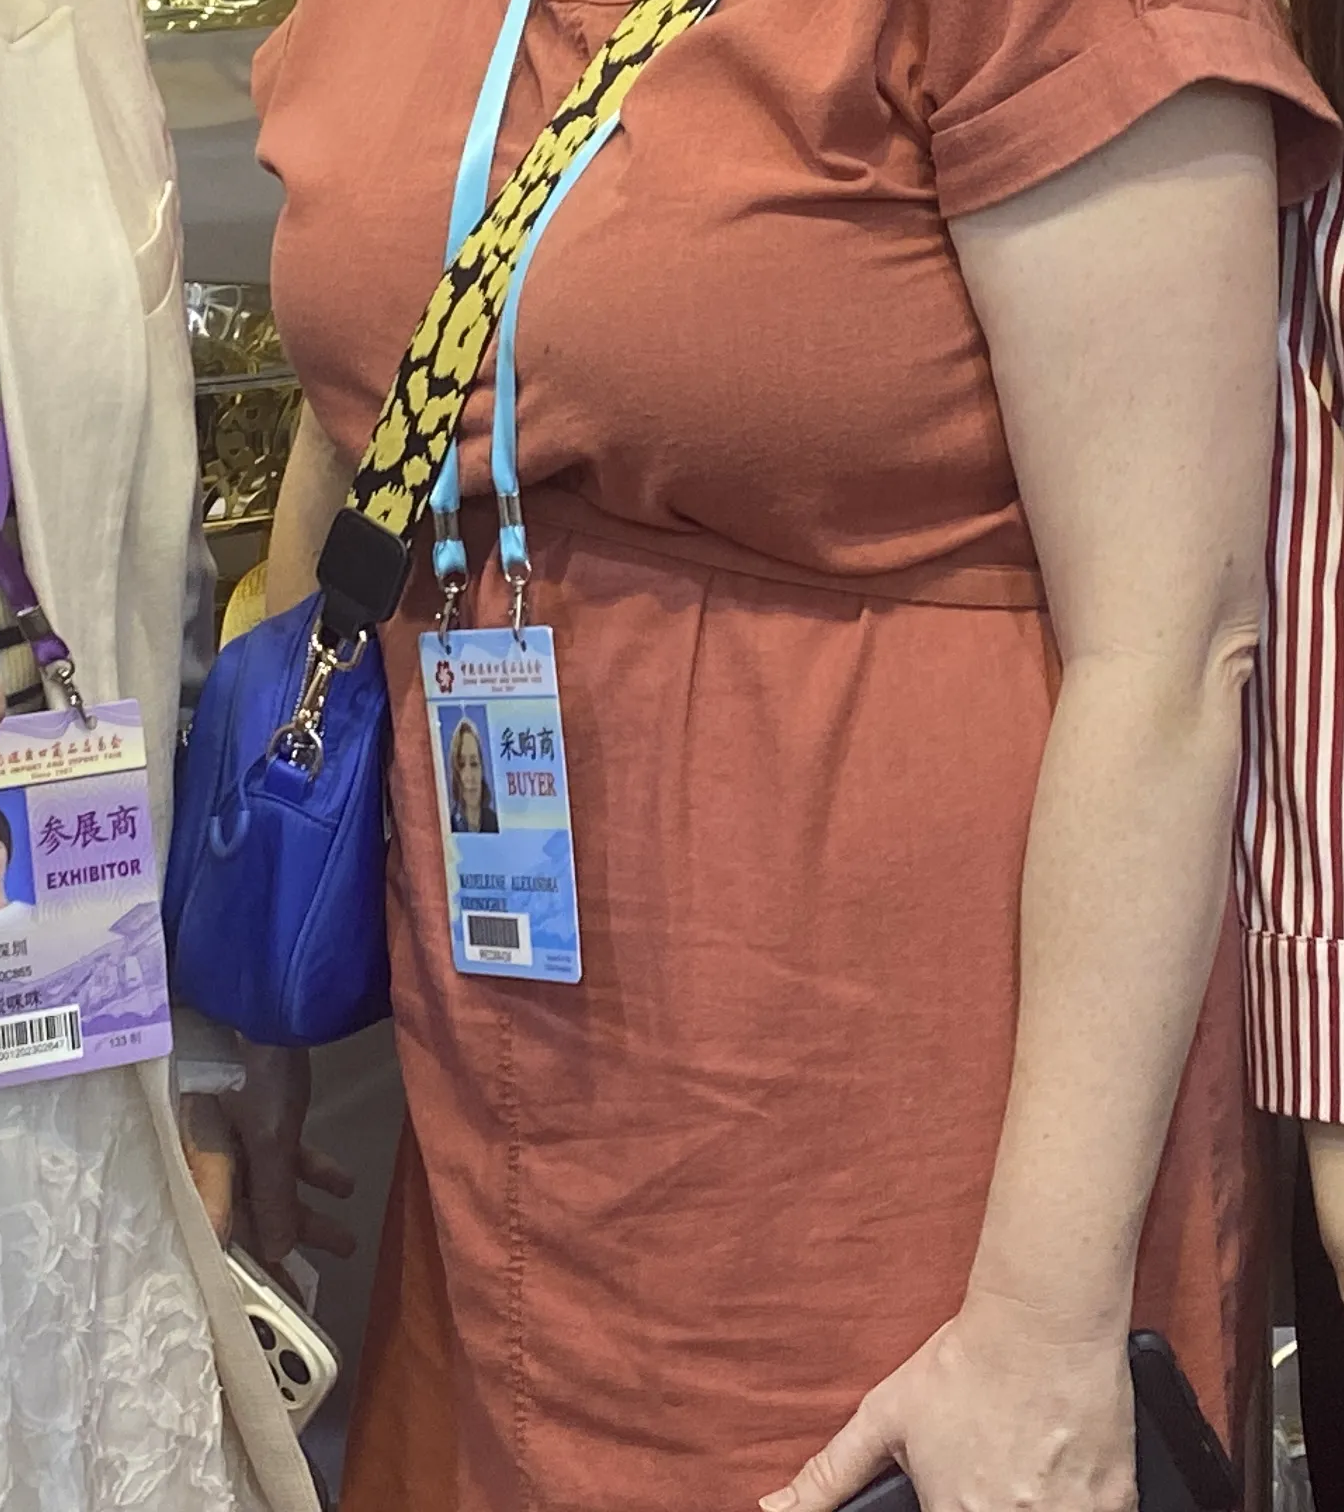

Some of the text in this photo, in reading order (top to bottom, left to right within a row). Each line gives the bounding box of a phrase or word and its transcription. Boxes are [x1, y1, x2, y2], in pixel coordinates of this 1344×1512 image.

[500, 727, 555, 762] 采购商
[506, 771, 557, 797] BUYER
[37, 805, 139, 856] 参展商
[46, 857, 142, 890] EXHIBITOR
